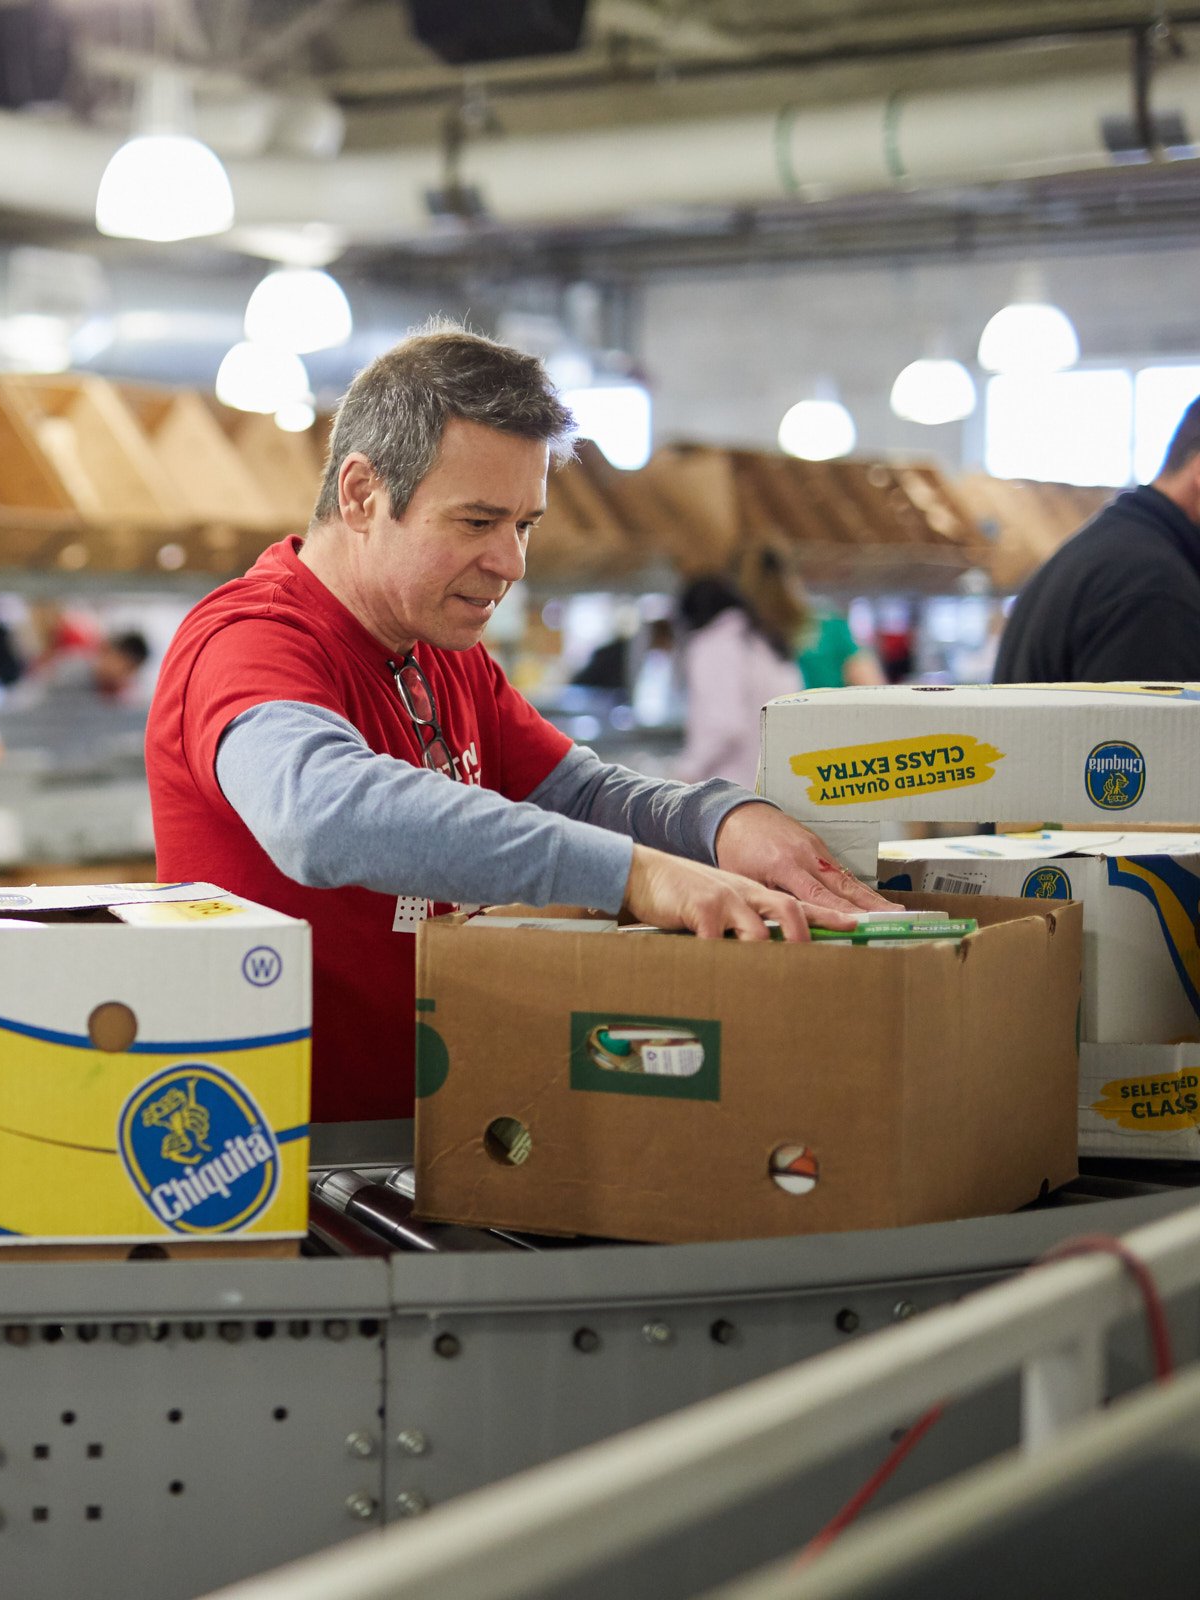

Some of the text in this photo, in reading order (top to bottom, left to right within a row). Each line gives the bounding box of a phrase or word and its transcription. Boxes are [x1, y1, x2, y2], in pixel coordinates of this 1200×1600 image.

[816, 745, 965, 782] CLASS EXTRA
[1088, 754, 1143, 774] Chiquita
[819, 766, 975, 801] SELECTED QUALITY
[1120, 1075, 1199, 1099] SELECTED
[1130, 1093, 1199, 1119] CLASS
[151, 1132, 274, 1222] Chiquita
